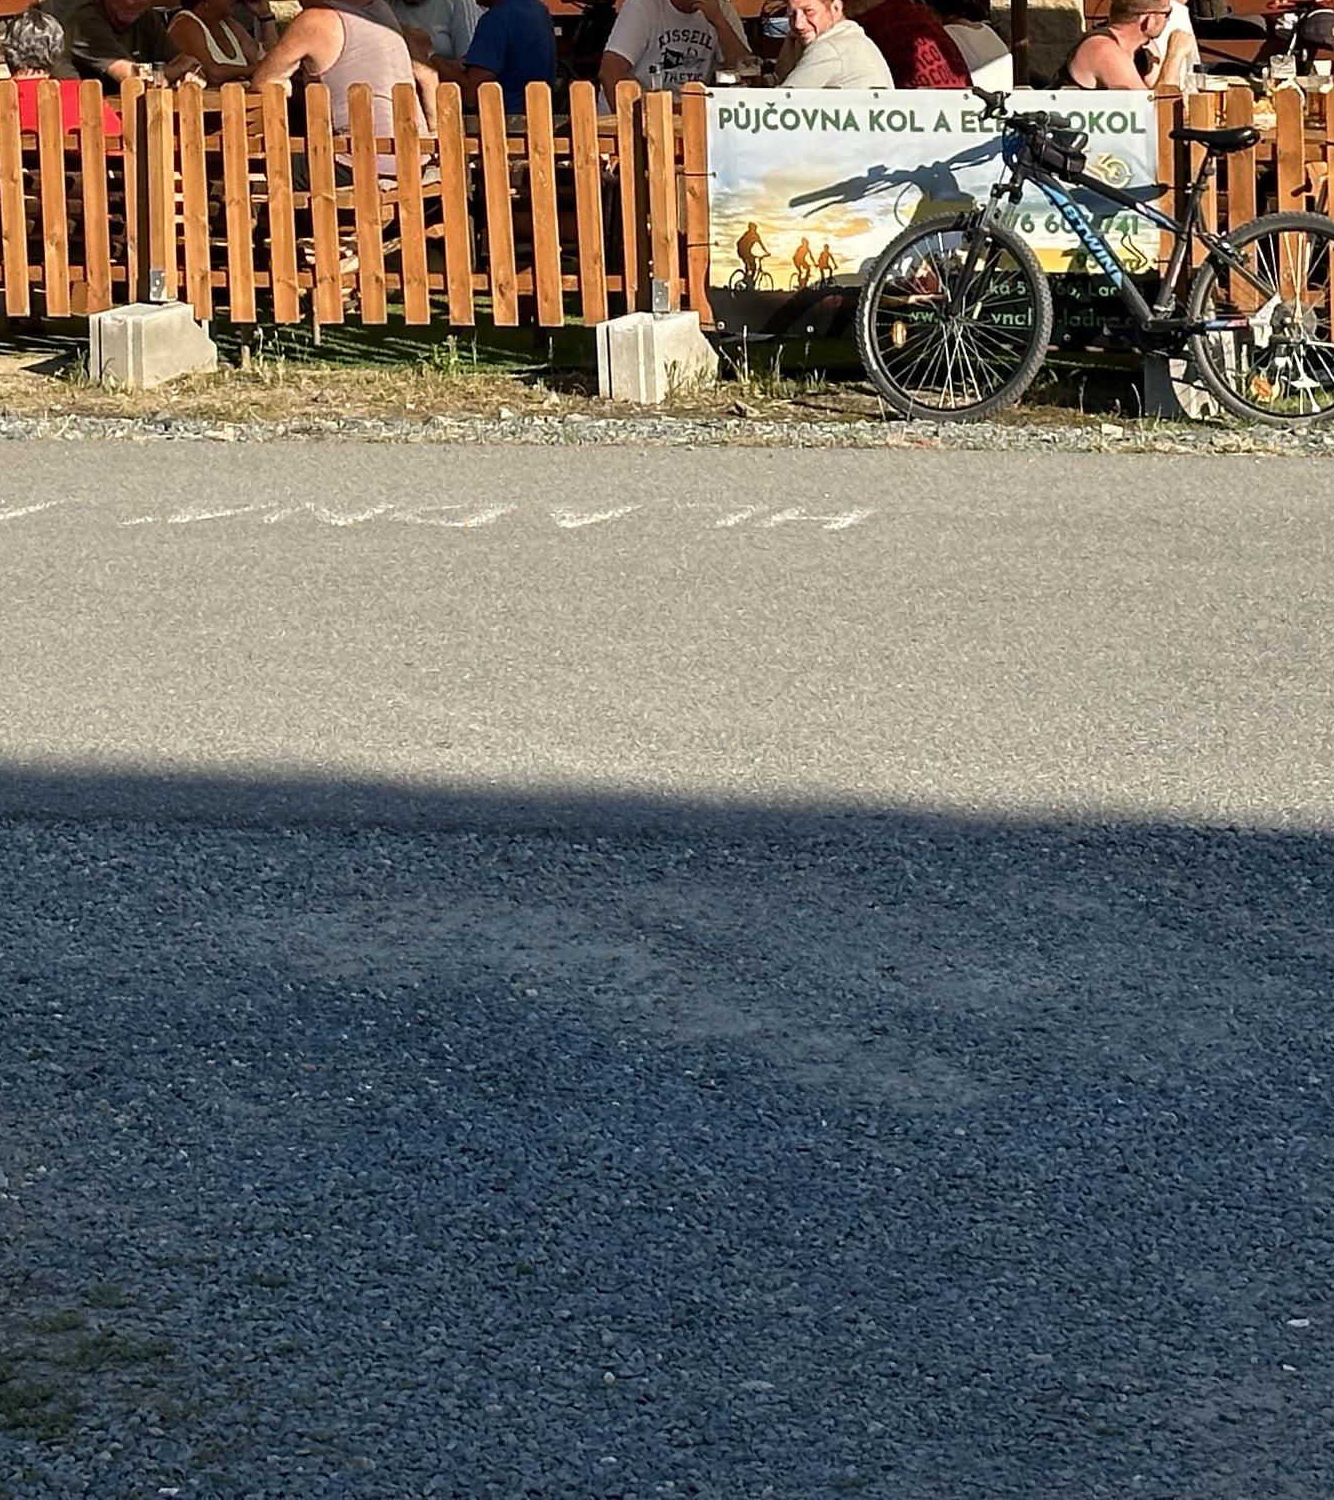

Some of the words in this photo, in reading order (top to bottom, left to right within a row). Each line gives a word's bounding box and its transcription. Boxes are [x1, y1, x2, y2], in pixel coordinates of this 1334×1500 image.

[719, 101, 860, 134] PŮJČOVNA
[869, 109, 924, 133] KOL
[933, 110, 953, 133] A
[961, 110, 1147, 134] ELEOKOL
